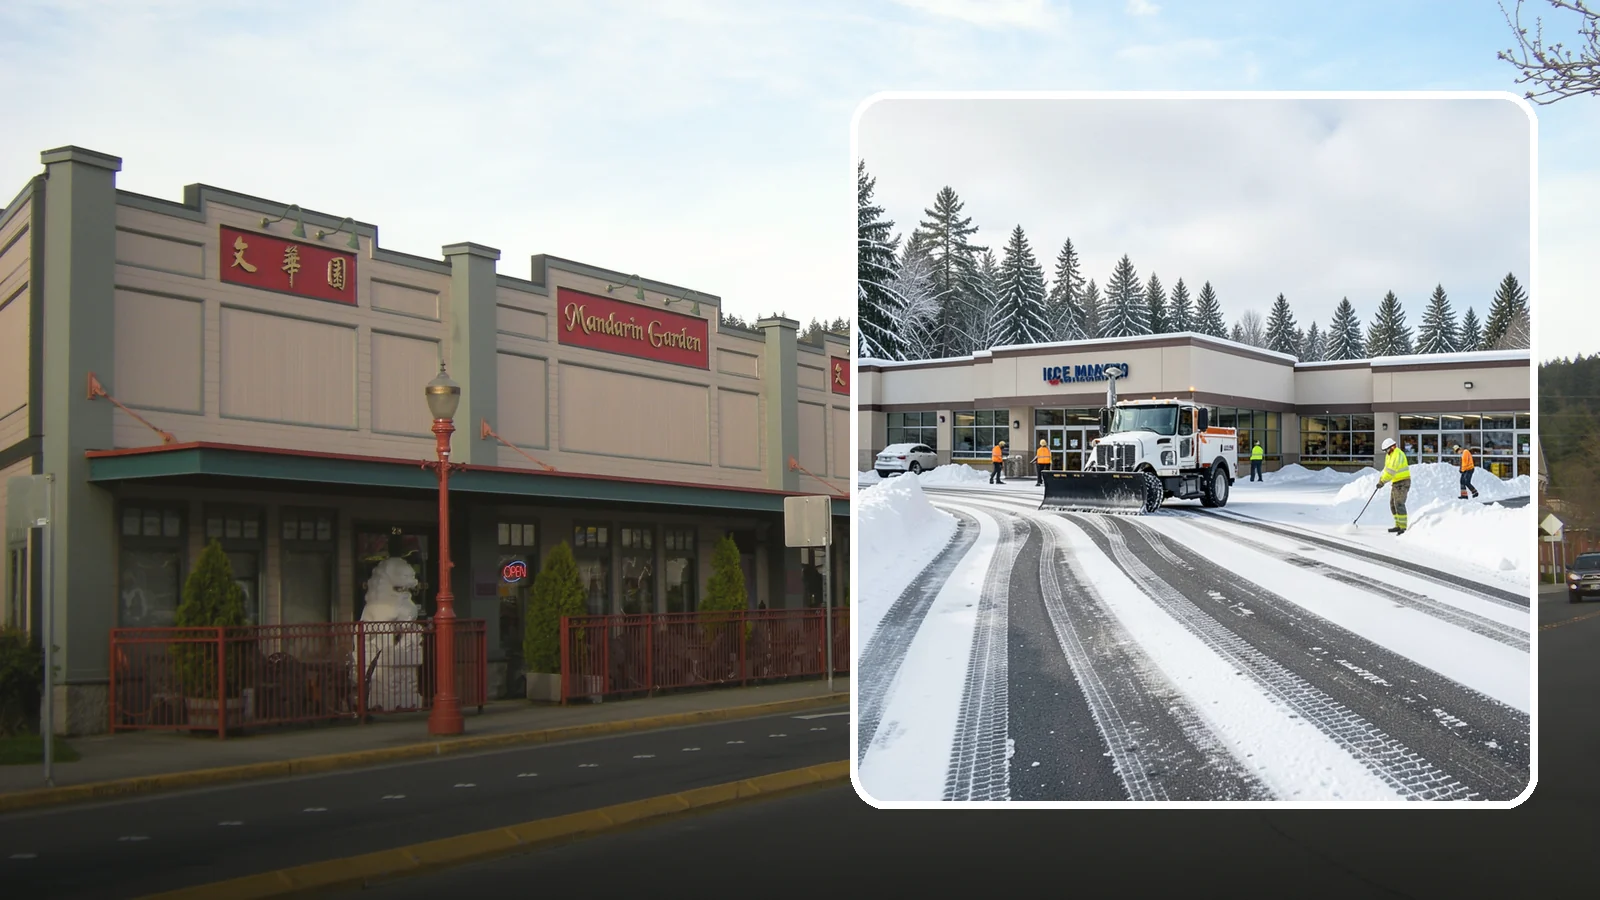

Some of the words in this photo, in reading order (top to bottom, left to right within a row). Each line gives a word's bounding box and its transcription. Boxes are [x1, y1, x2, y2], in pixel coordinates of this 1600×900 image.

[231, 235, 346, 291] 文華園
[564, 302, 644, 341] Mandarin
[648, 320, 702, 352] Garden
[503, 565, 527, 578] OPEN
